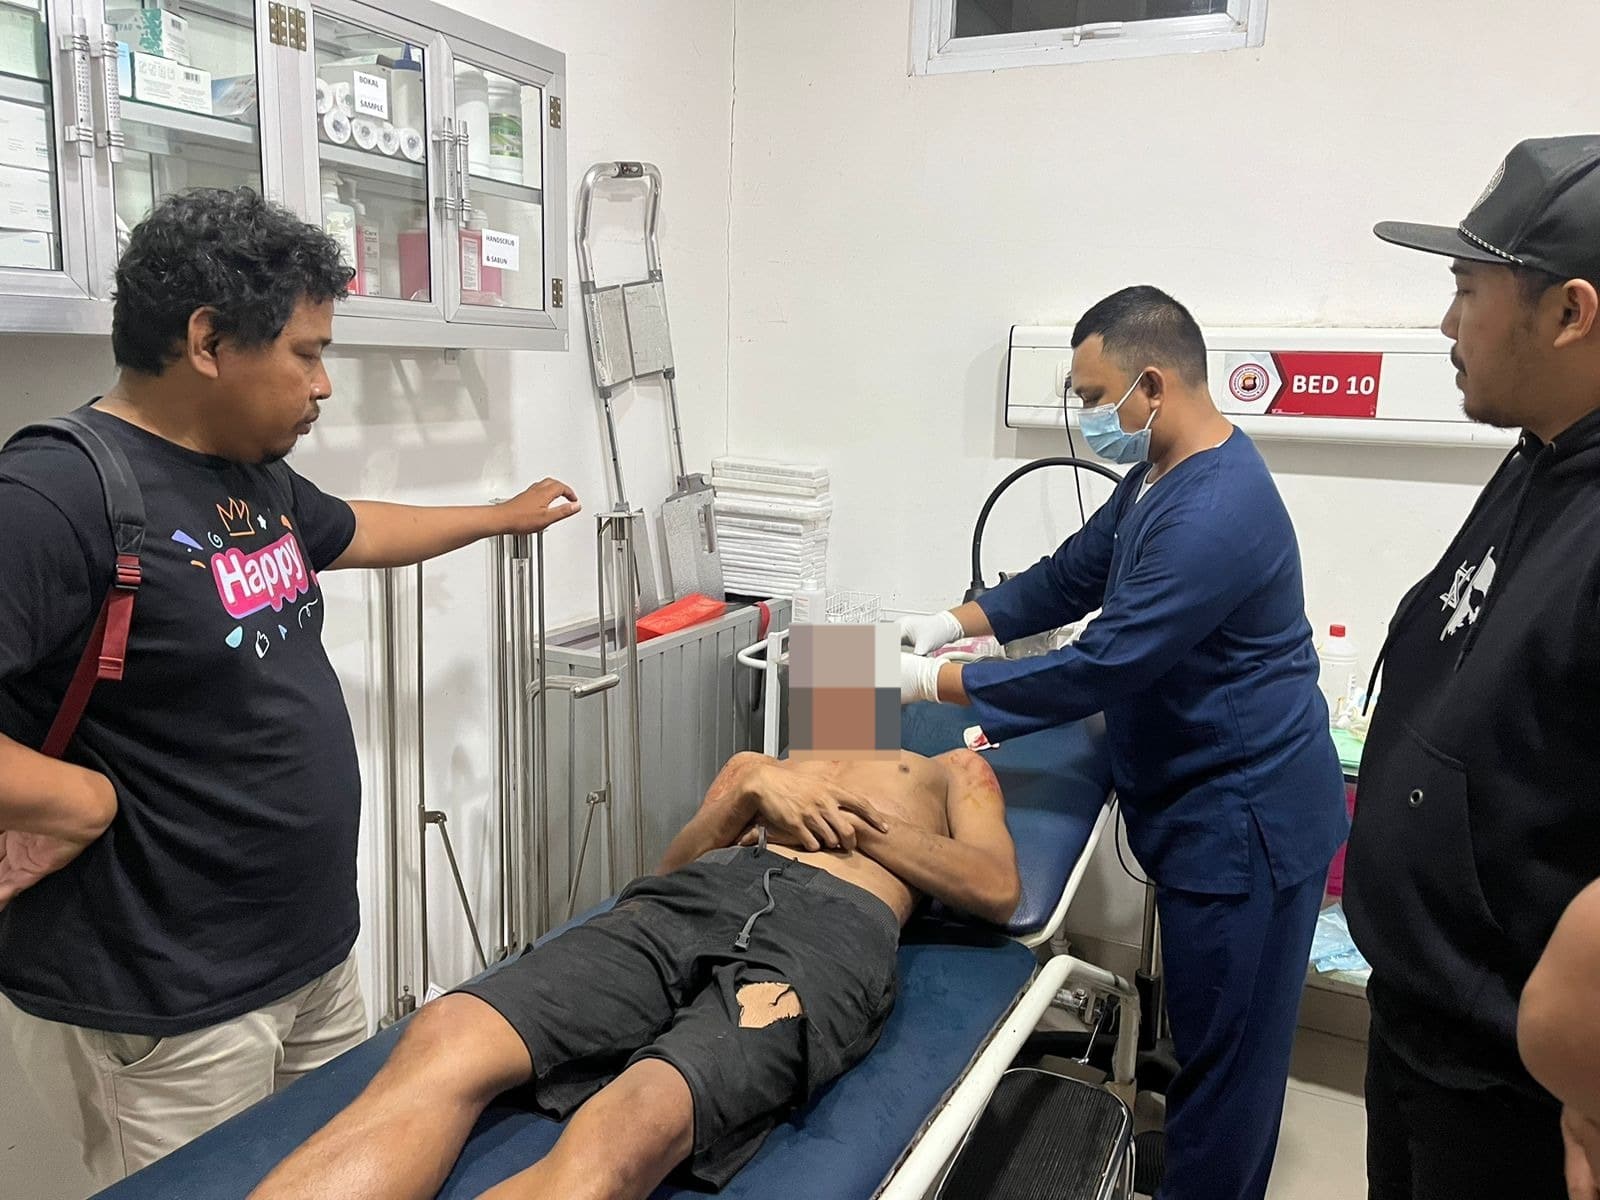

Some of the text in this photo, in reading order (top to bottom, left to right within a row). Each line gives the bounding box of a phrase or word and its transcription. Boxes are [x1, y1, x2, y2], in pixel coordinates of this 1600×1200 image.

[360, 99, 384, 113] SAMPLE
[491, 256, 508, 265] SABUN
[1292, 374, 1375, 395] BED 10
[215, 537, 303, 604] Happy
